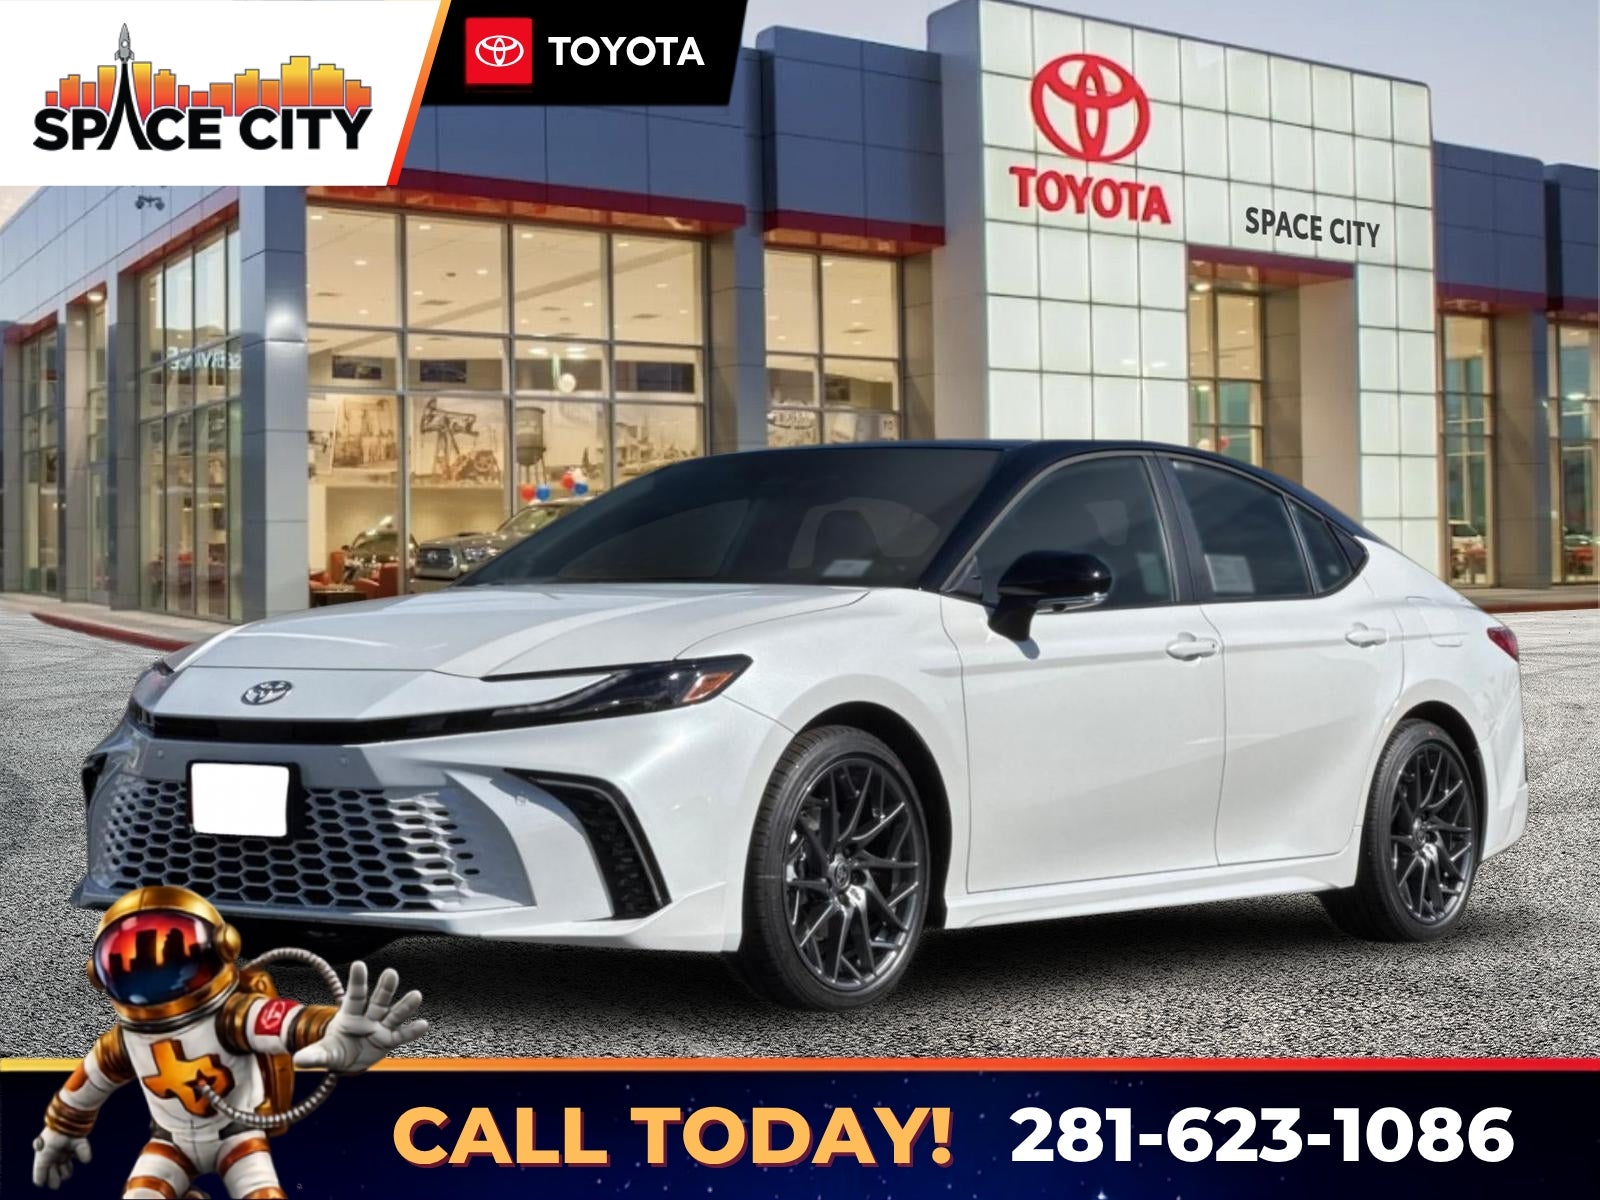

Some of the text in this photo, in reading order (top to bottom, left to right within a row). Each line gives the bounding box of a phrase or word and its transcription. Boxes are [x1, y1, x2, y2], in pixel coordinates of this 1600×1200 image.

[1010, 166, 1171, 225] TOYOTA
[1245, 206, 1380, 248] SPACE CITY
